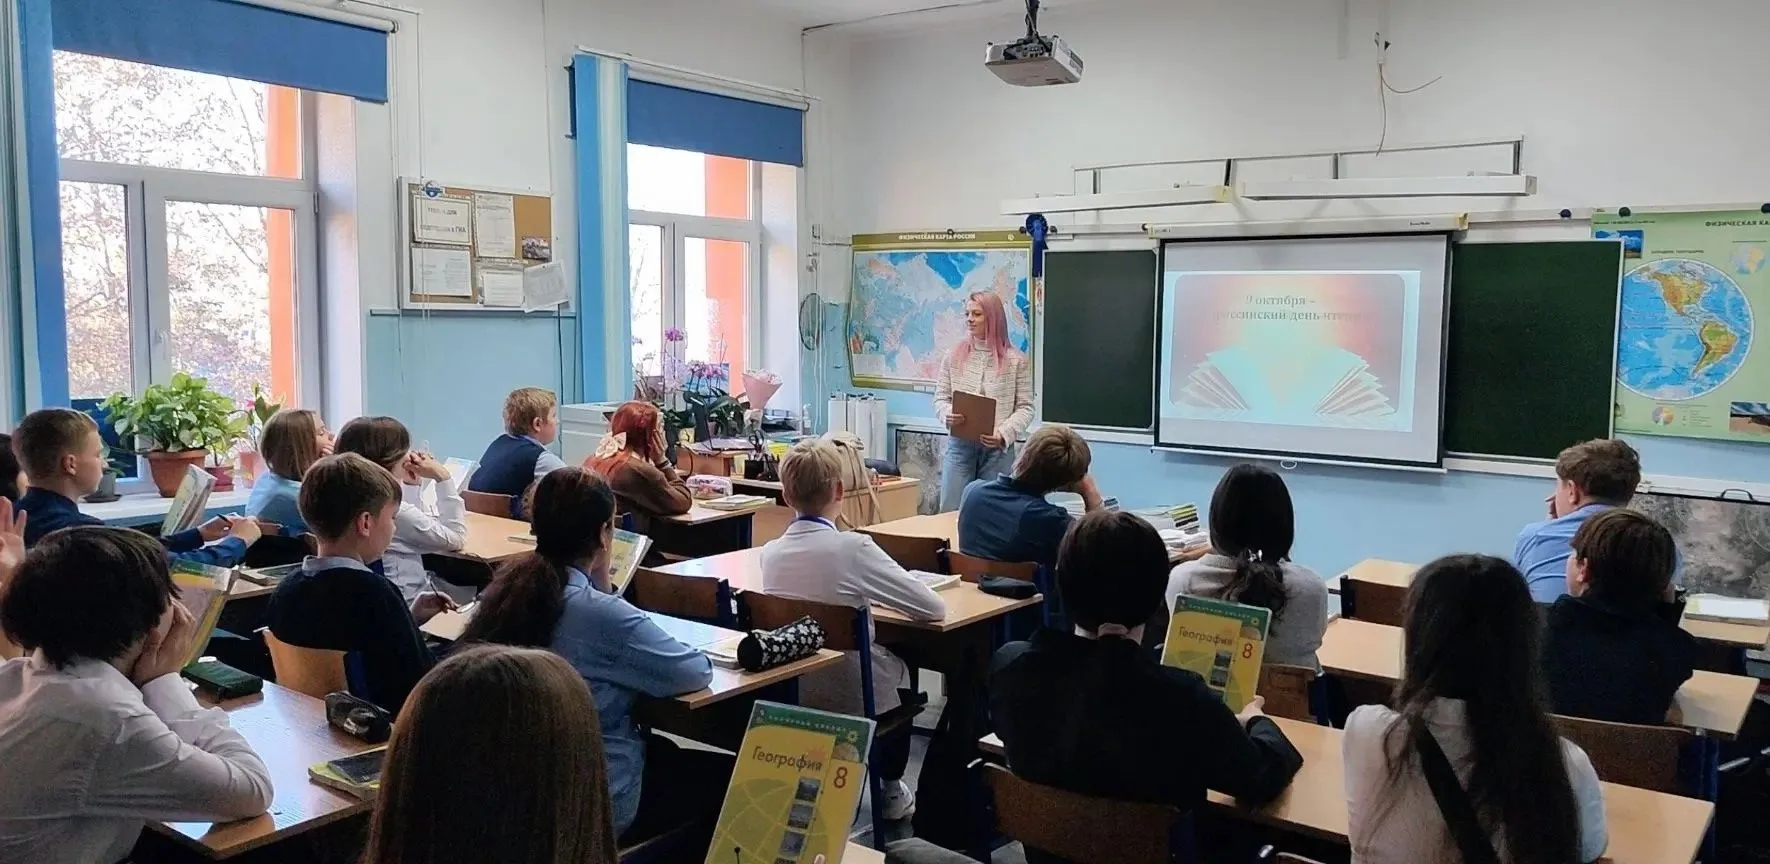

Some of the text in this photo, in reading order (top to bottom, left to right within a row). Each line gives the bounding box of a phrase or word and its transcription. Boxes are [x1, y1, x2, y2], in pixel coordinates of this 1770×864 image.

[1255, 294, 1306, 308] октября
[1289, 310, 1320, 321] день
[1179, 625, 1253, 659] География 8
[751, 744, 848, 789] География 8
